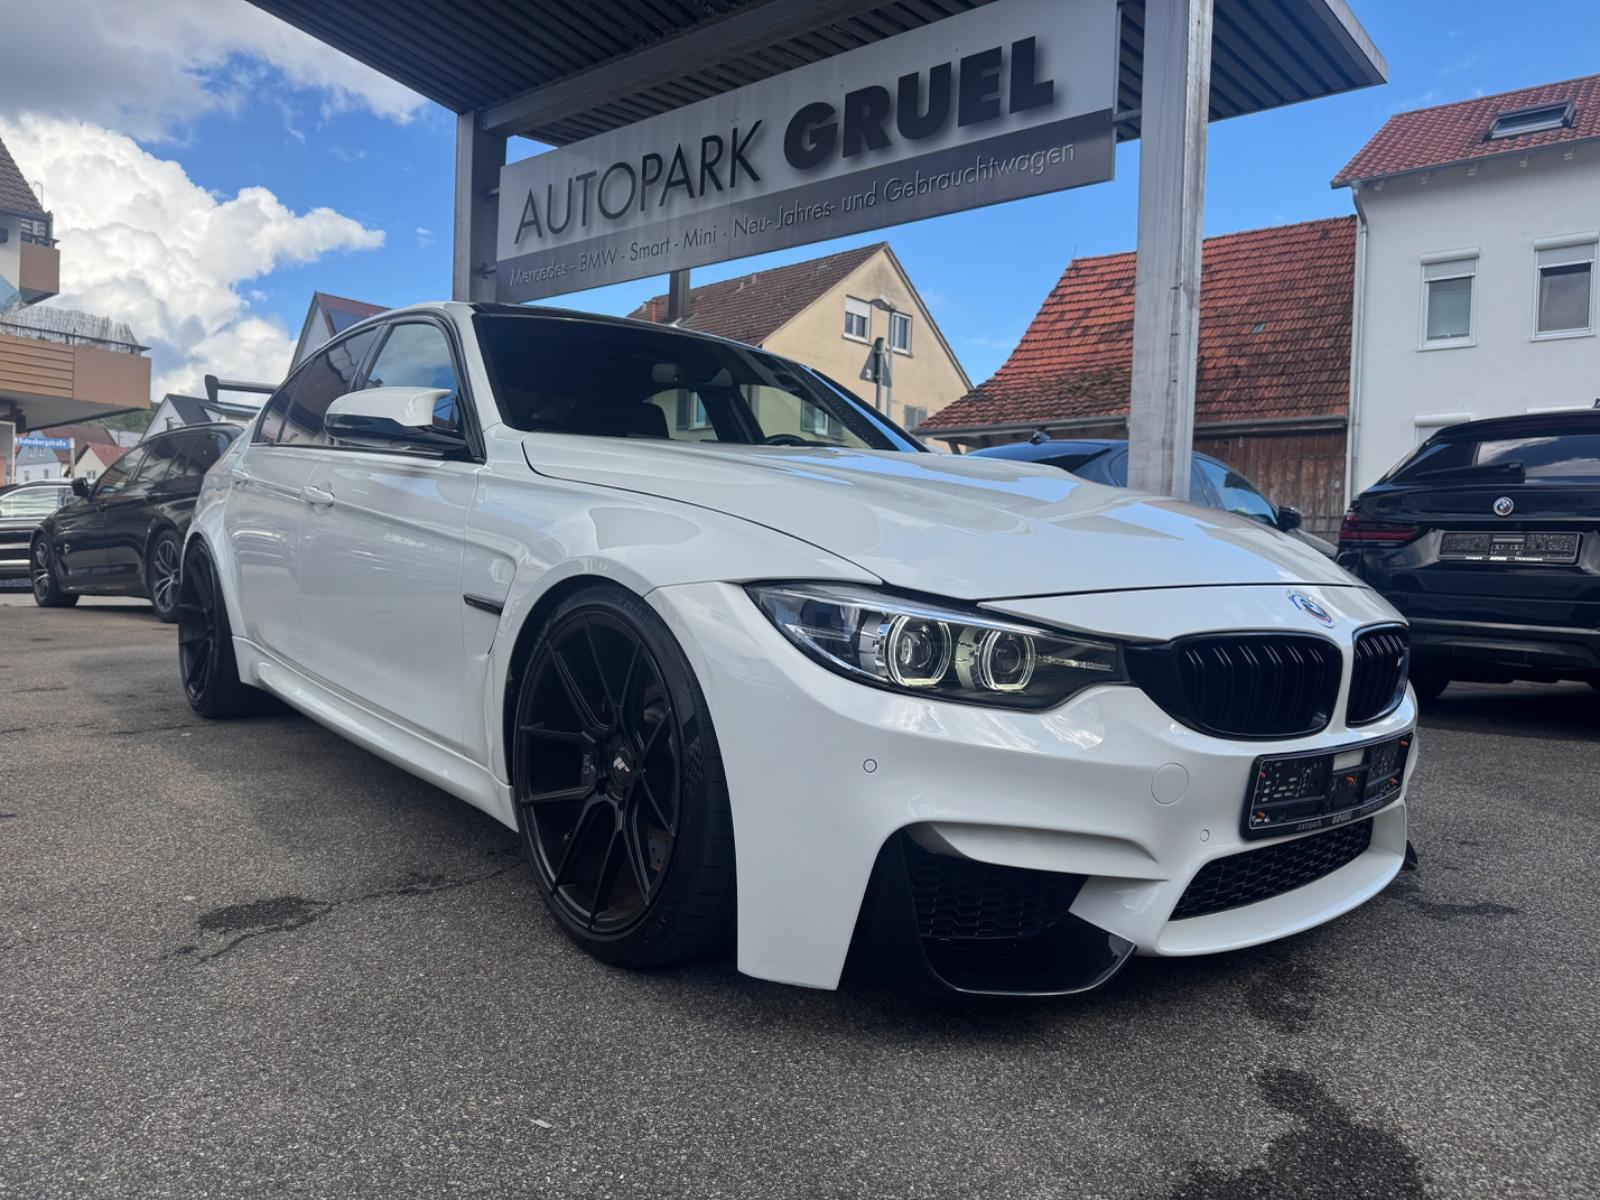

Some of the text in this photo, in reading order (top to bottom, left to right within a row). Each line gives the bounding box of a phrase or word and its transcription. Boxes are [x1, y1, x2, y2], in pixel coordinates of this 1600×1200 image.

[510, 259, 568, 287] Mercedes
[578, 246, 618, 273] BMW
[630, 237, 670, 261] Smart
[683, 225, 717, 249] Mini
[775, 200, 837, 230] Jahres-
[841, 179, 878, 212] und
[883, 143, 1075, 201] Gebrauchtwagen
[514, 36, 1054, 244] AUTOPARK GRUEL
